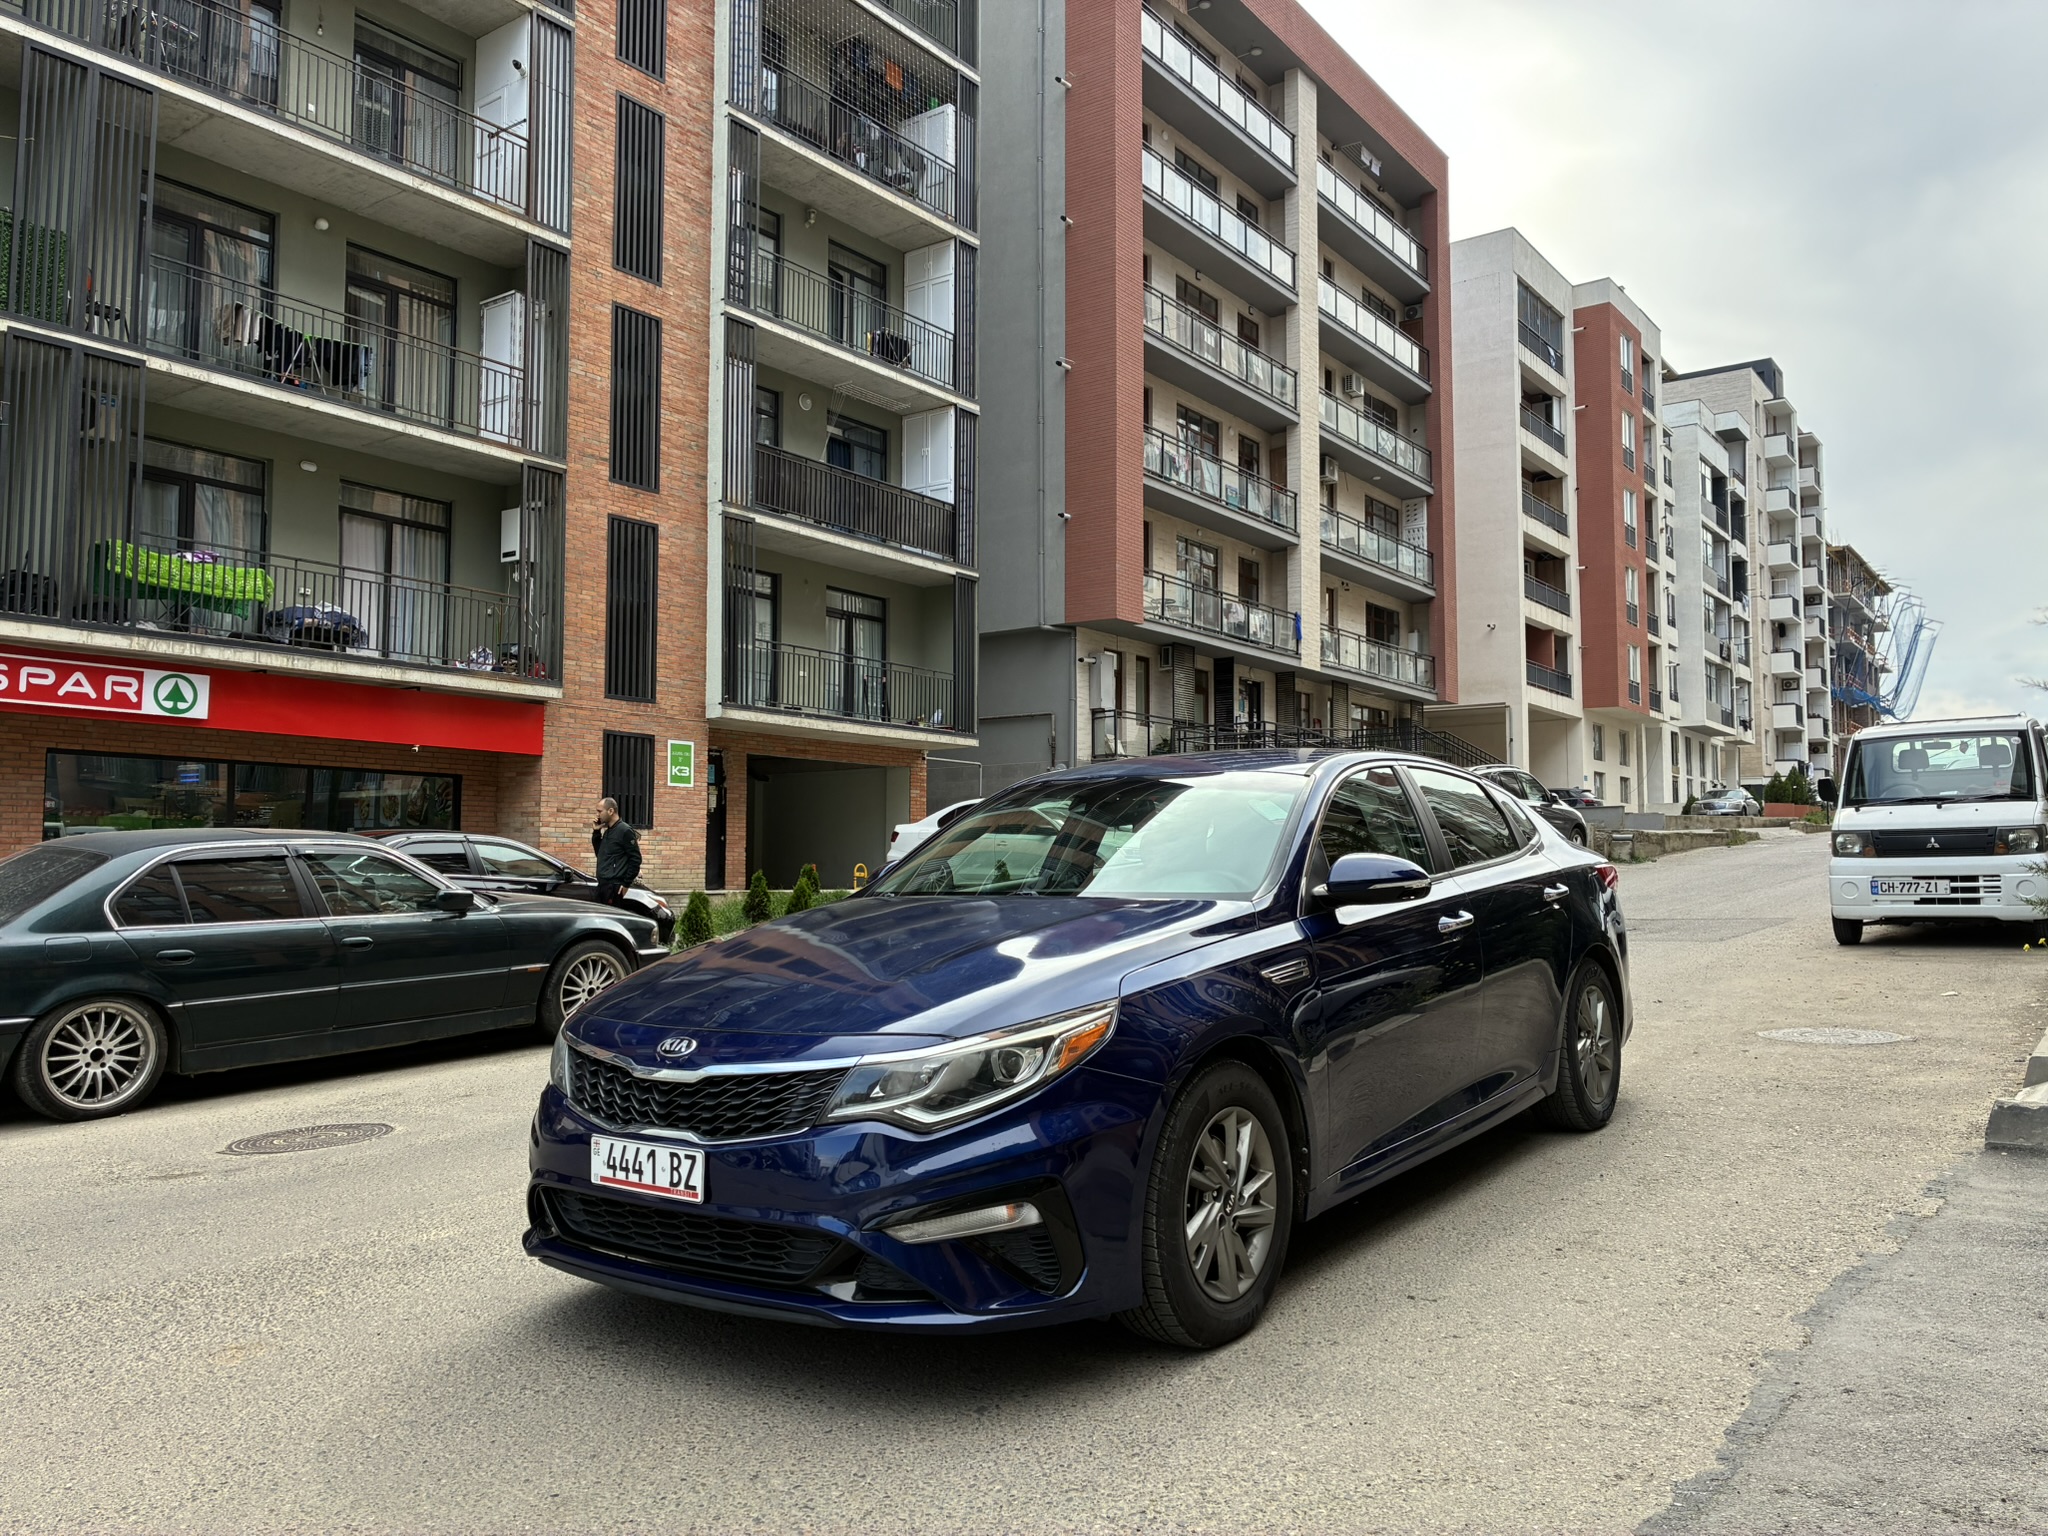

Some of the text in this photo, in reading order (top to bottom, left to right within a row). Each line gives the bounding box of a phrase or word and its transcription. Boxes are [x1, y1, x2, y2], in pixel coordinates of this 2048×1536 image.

[0, 663, 139, 703] PAR
[661, 1039, 689, 1052] KIA
[607, 1143, 697, 1191] 4441 BZ
[670, 1187, 694, 1199] TRANSIT
[1226, 1194, 1235, 1213] KIA
